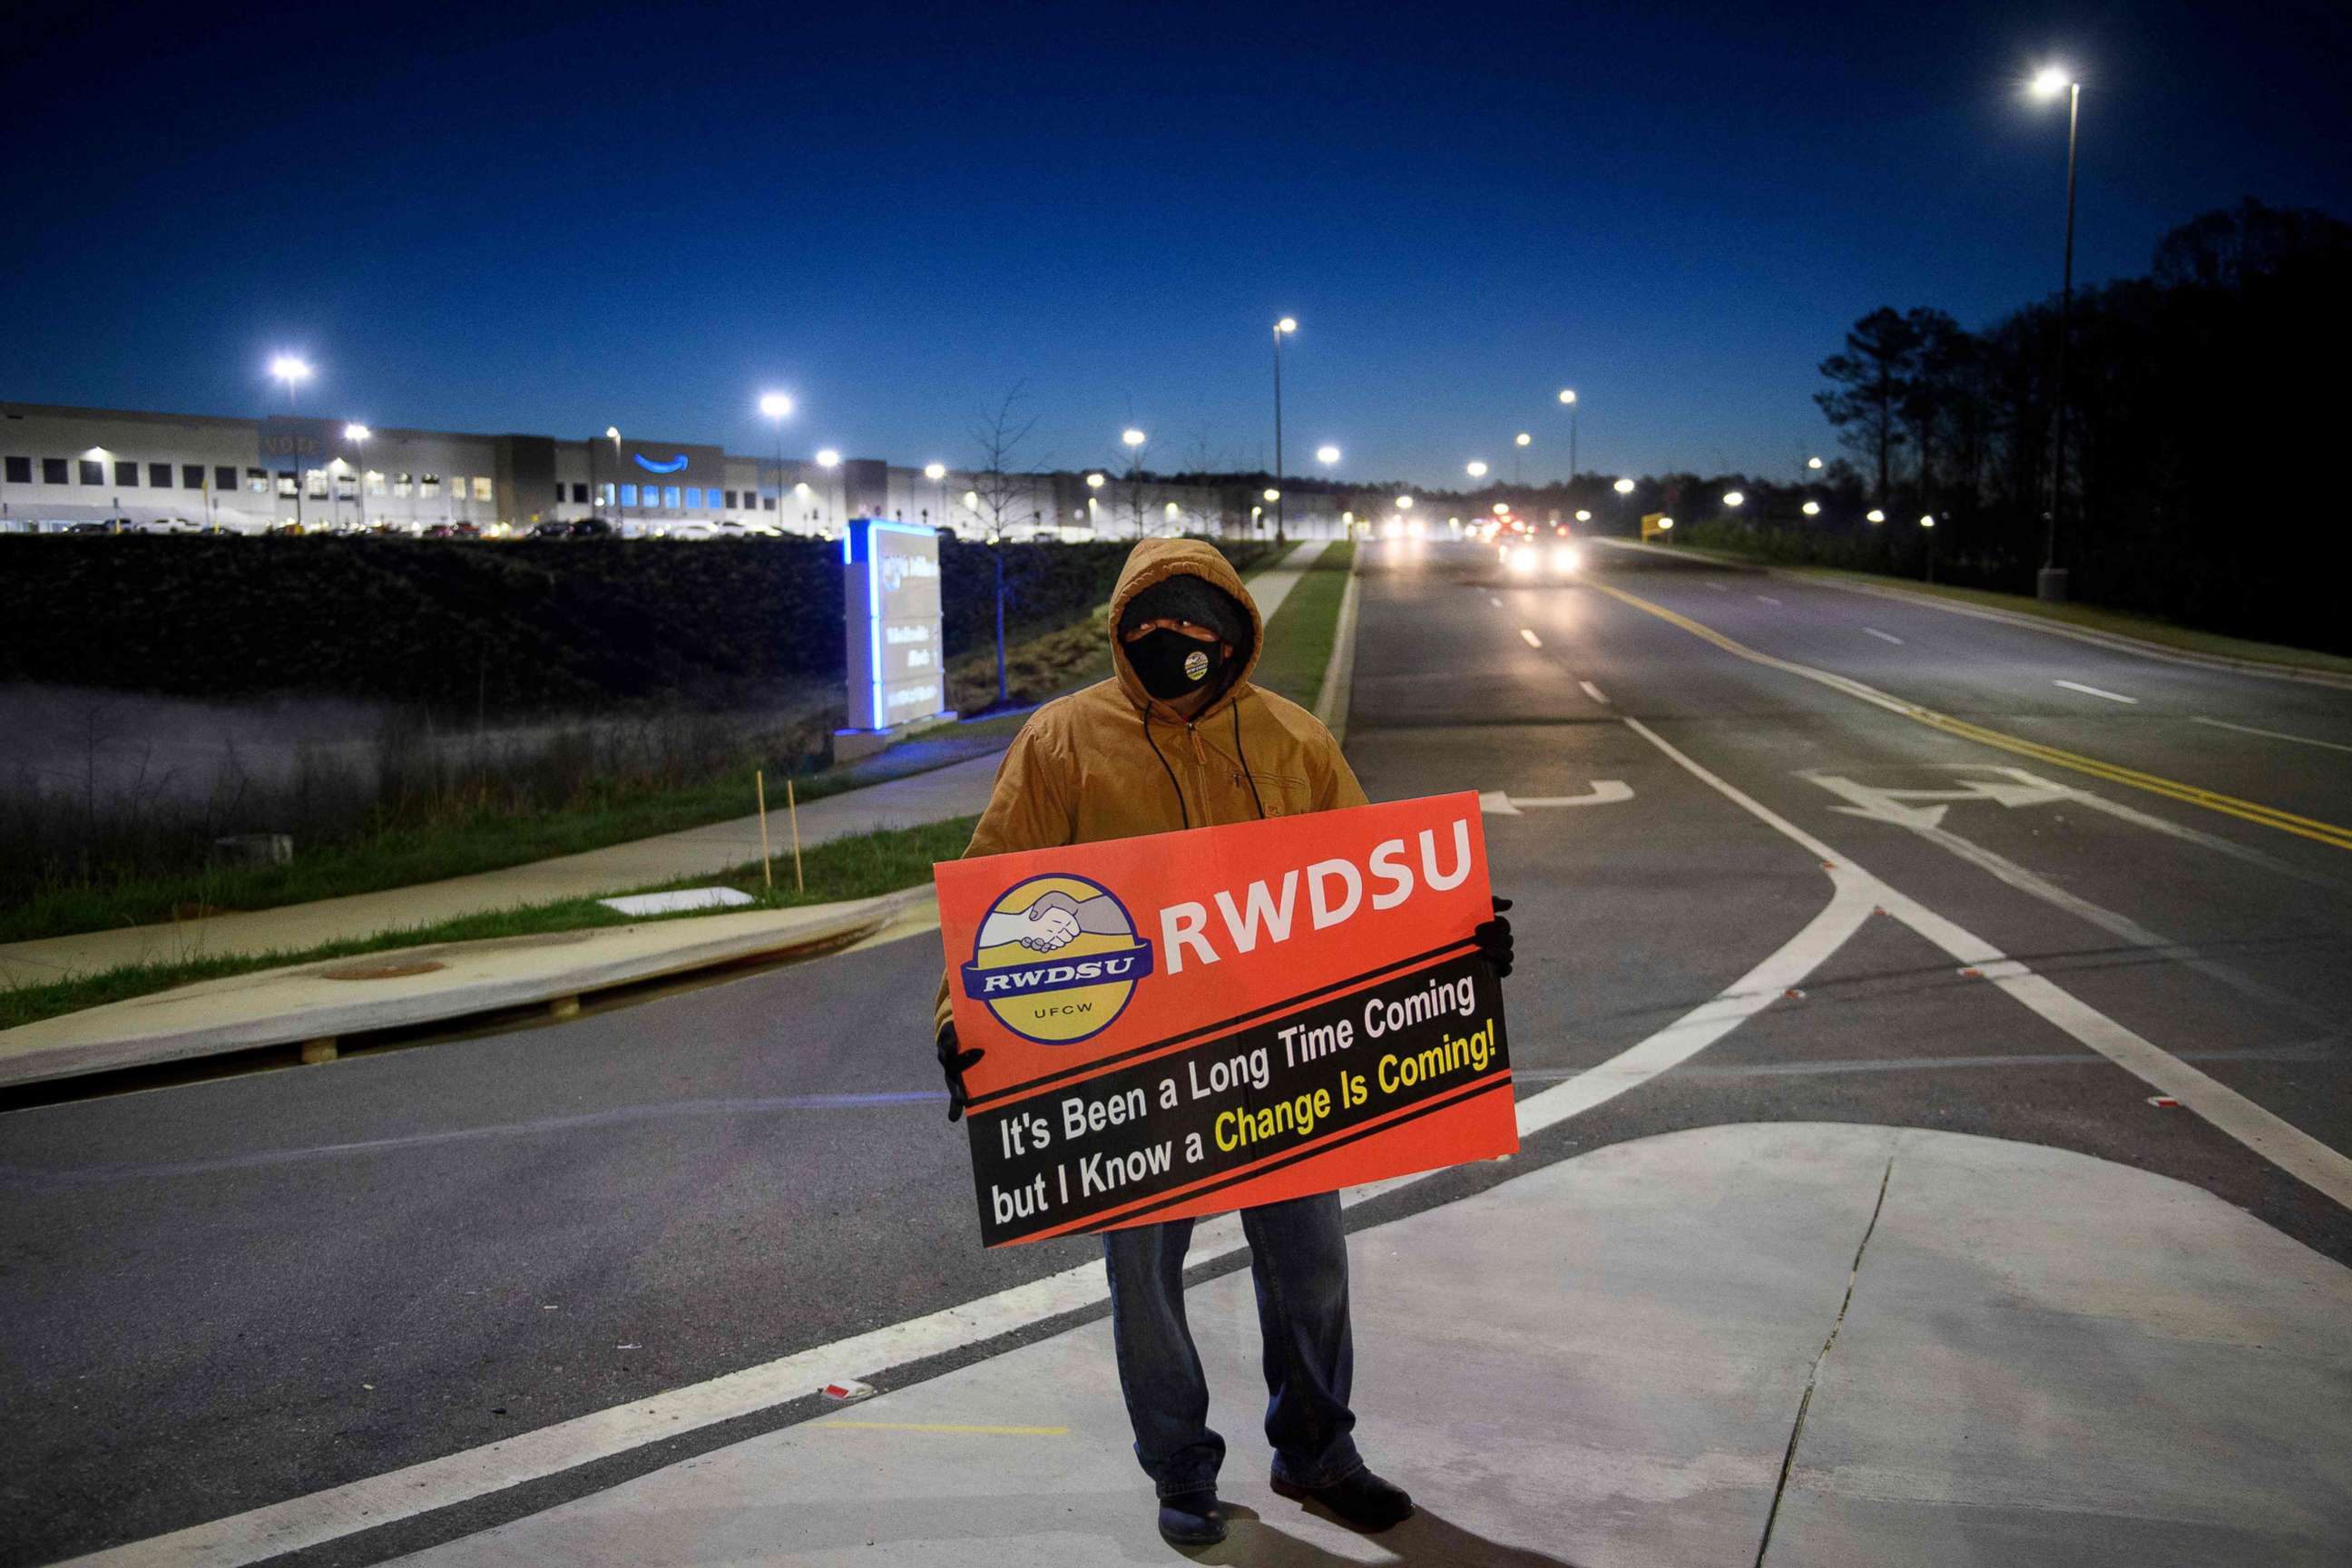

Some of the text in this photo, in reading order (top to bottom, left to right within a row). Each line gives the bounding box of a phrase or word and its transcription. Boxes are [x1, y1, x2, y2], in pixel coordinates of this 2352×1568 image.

[983, 956, 1134, 992] RWDSU
[1160, 818, 1472, 975] RWDSU
[1000, 975, 1475, 1160] It's Been a Long Time Coming
[1034, 1003, 1093, 1018] UFCW
[992, 1018, 1496, 1225] but I Know a Change Is Coming!
